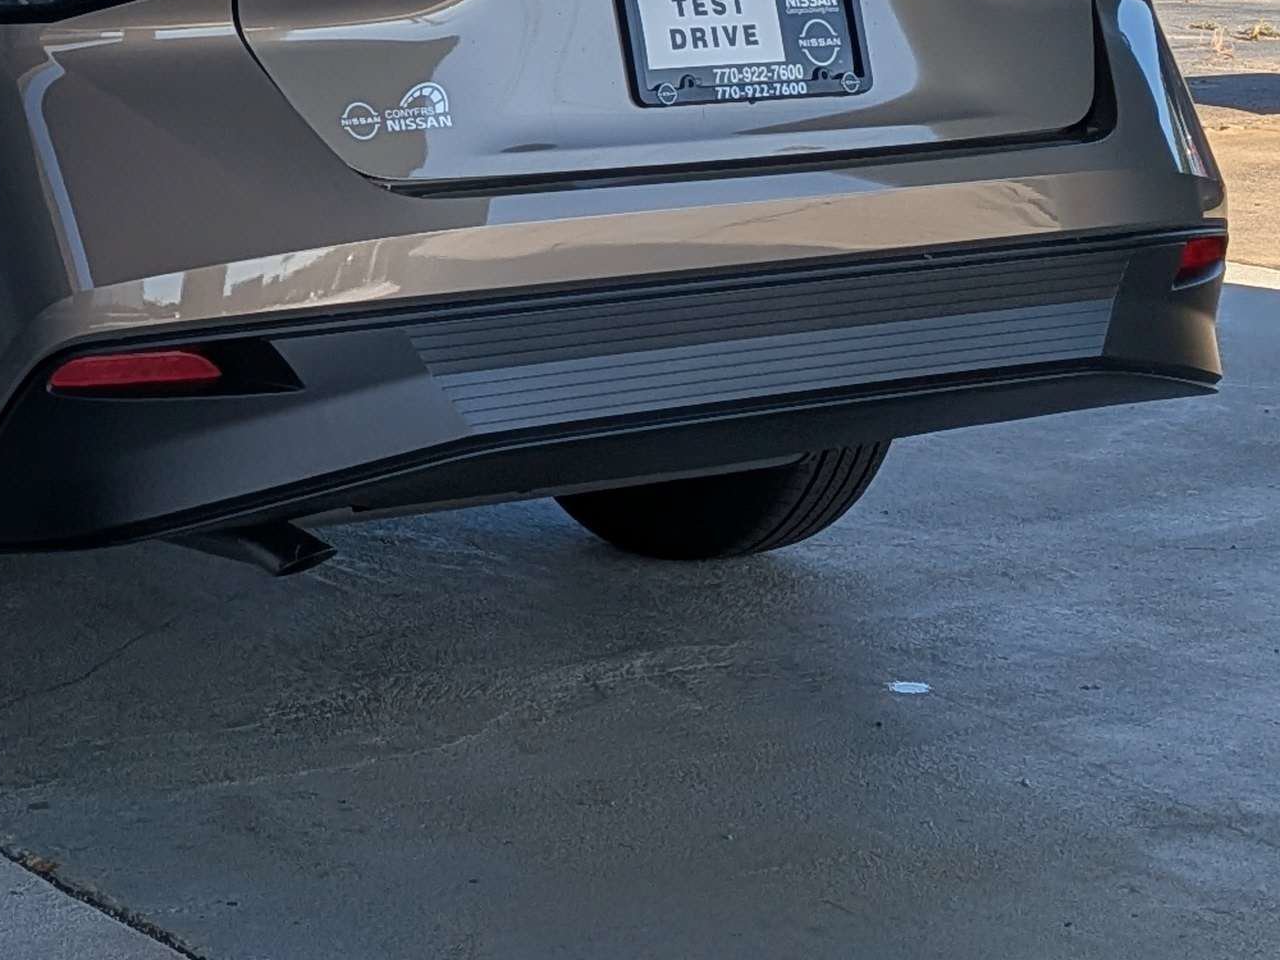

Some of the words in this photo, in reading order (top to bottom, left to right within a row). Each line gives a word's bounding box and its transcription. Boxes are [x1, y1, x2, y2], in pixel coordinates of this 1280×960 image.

[670, 24, 760, 51] DRIVE
[798, 37, 842, 48] NISSAN
[713, 63, 804, 85] 770-922-7600
[714, 81, 808, 100] 770-922-7600
[341, 115, 382, 127] NISSAN
[385, 114, 453, 133] NISSAN
